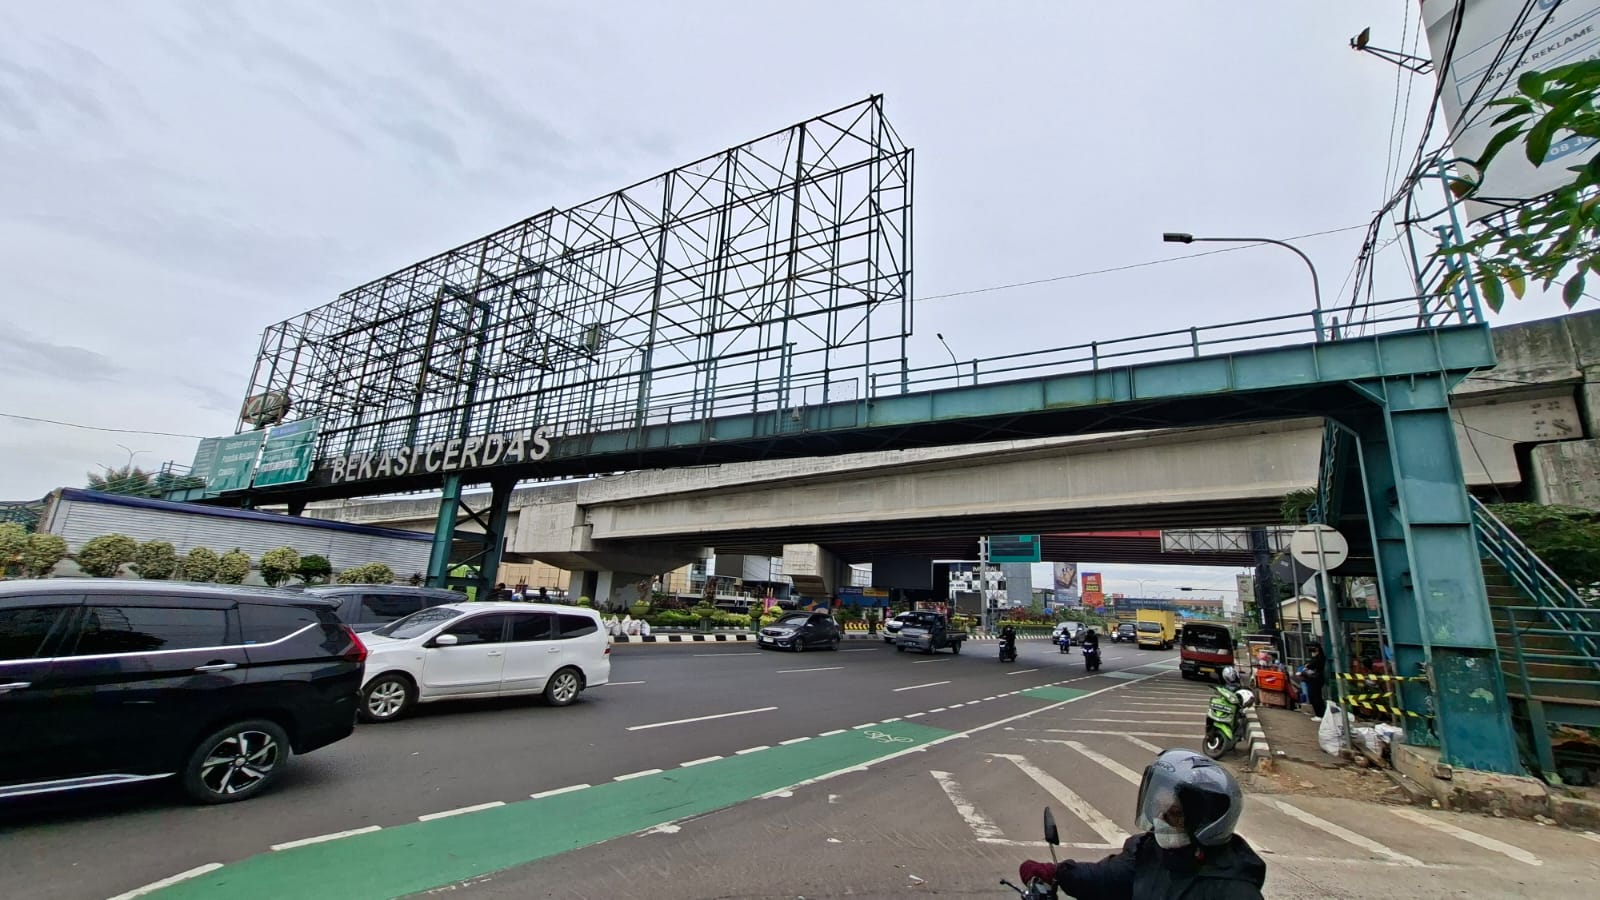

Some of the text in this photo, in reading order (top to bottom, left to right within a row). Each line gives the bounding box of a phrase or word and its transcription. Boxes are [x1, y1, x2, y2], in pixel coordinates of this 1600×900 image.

[1531, 25, 1594, 60] REKLAME
[330, 425, 551, 484] BEKASI CERDAS
